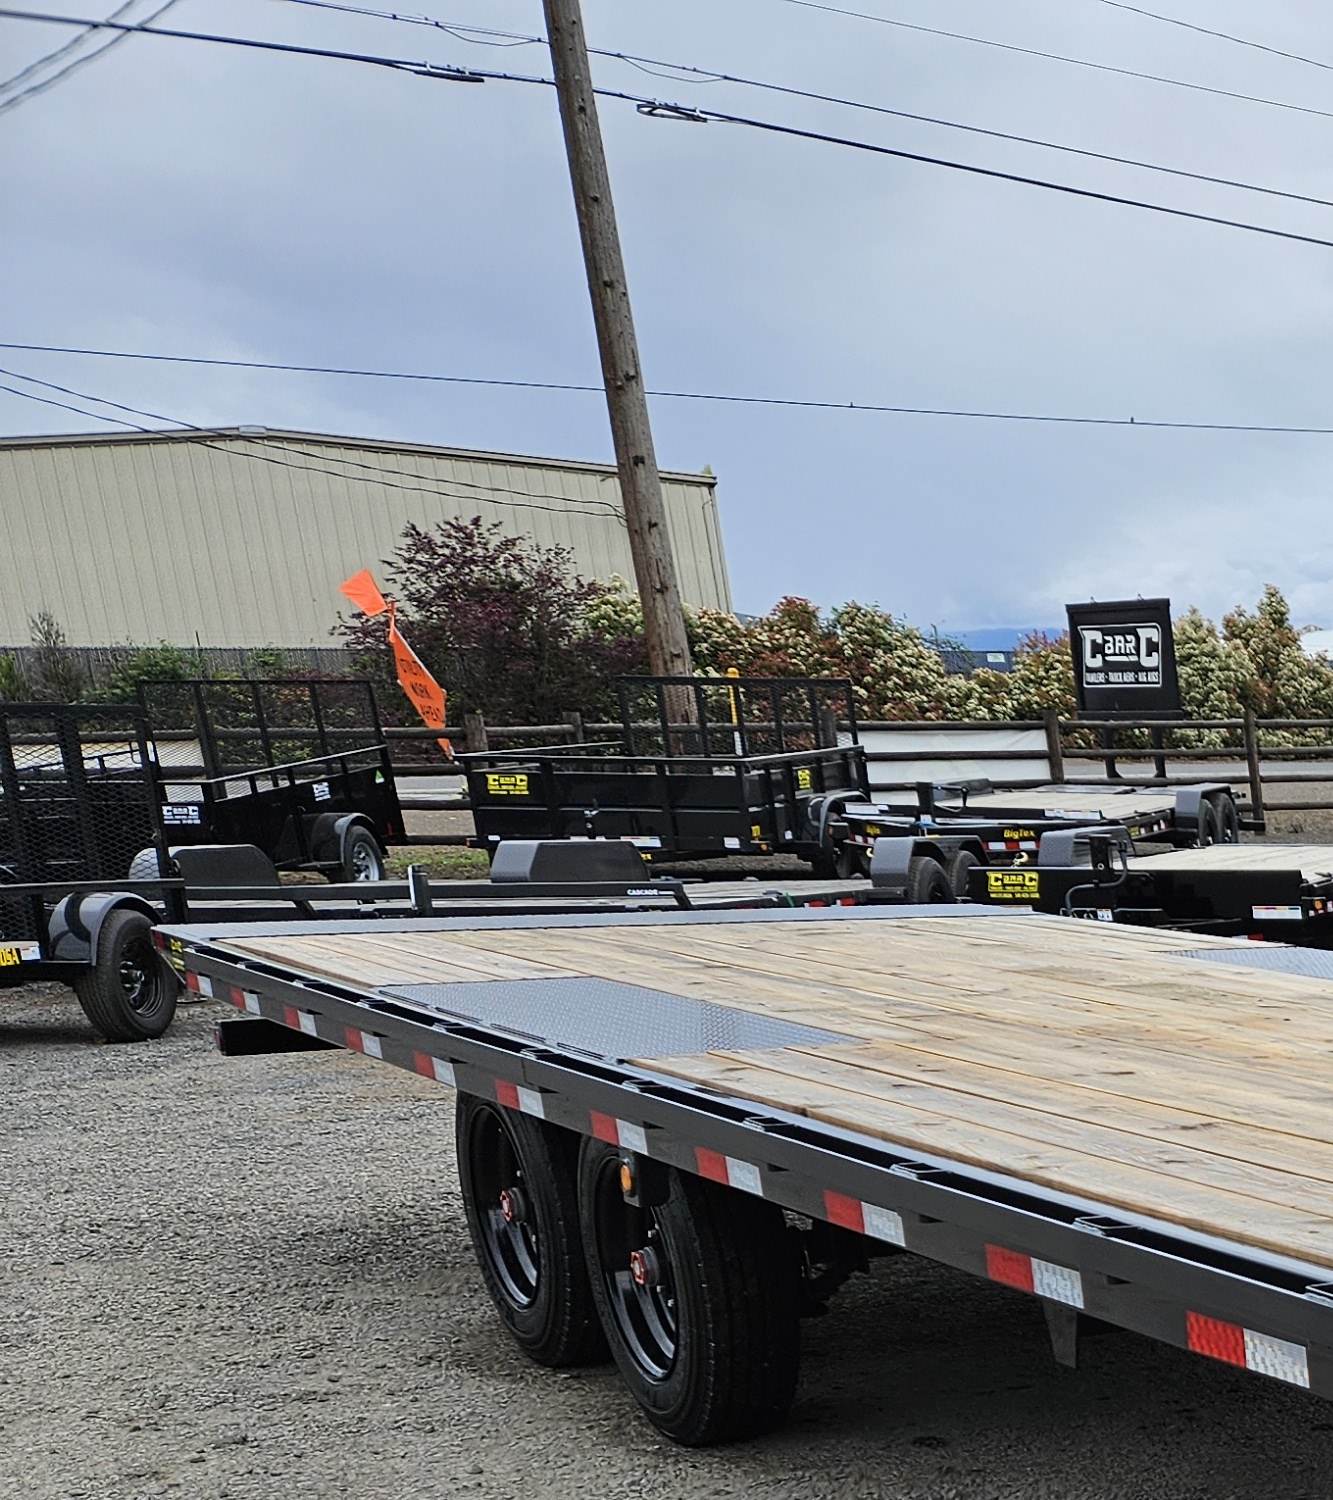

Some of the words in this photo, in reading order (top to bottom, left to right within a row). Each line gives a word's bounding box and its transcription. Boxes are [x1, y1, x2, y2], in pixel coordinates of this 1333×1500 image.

[1082, 630, 1102, 668] C
[1103, 634, 1137, 655] BAR
[1136, 627, 1158, 667] C
[1003, 828, 1036, 840] BigTex
